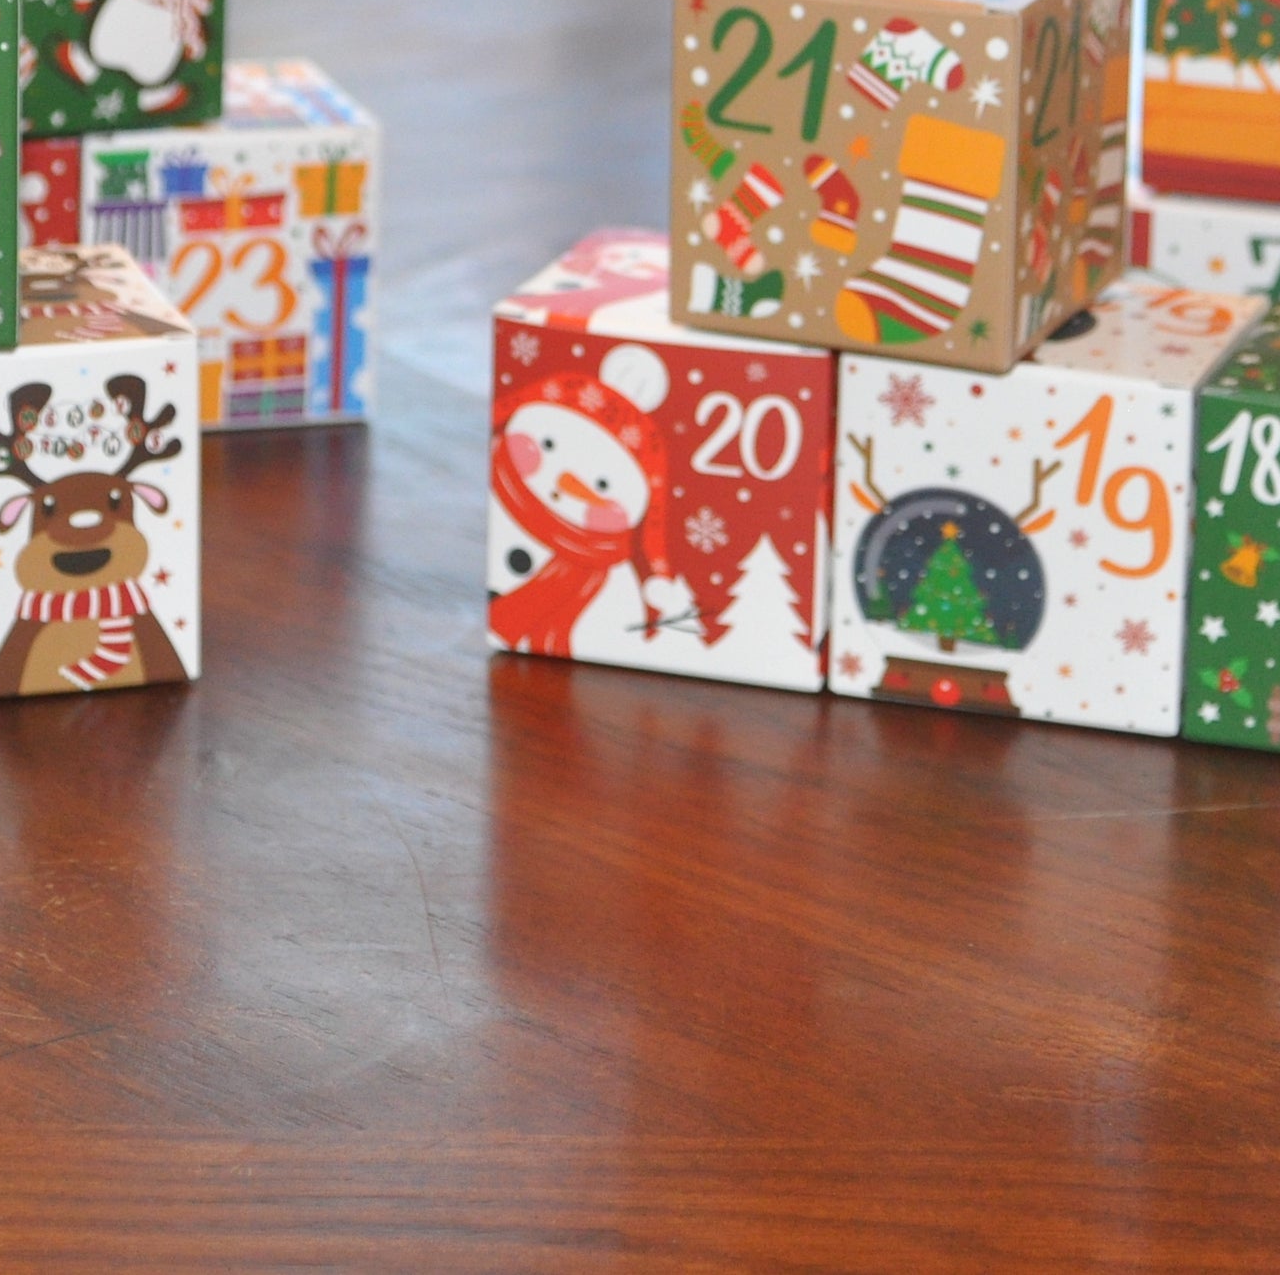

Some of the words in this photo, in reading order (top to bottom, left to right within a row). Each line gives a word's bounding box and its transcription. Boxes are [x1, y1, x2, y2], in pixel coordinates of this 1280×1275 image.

[705, 6, 838, 142] 21
[171, 238, 297, 333] 23
[690, 391, 803, 481] 20
[1053, 394, 1172, 579] 19
